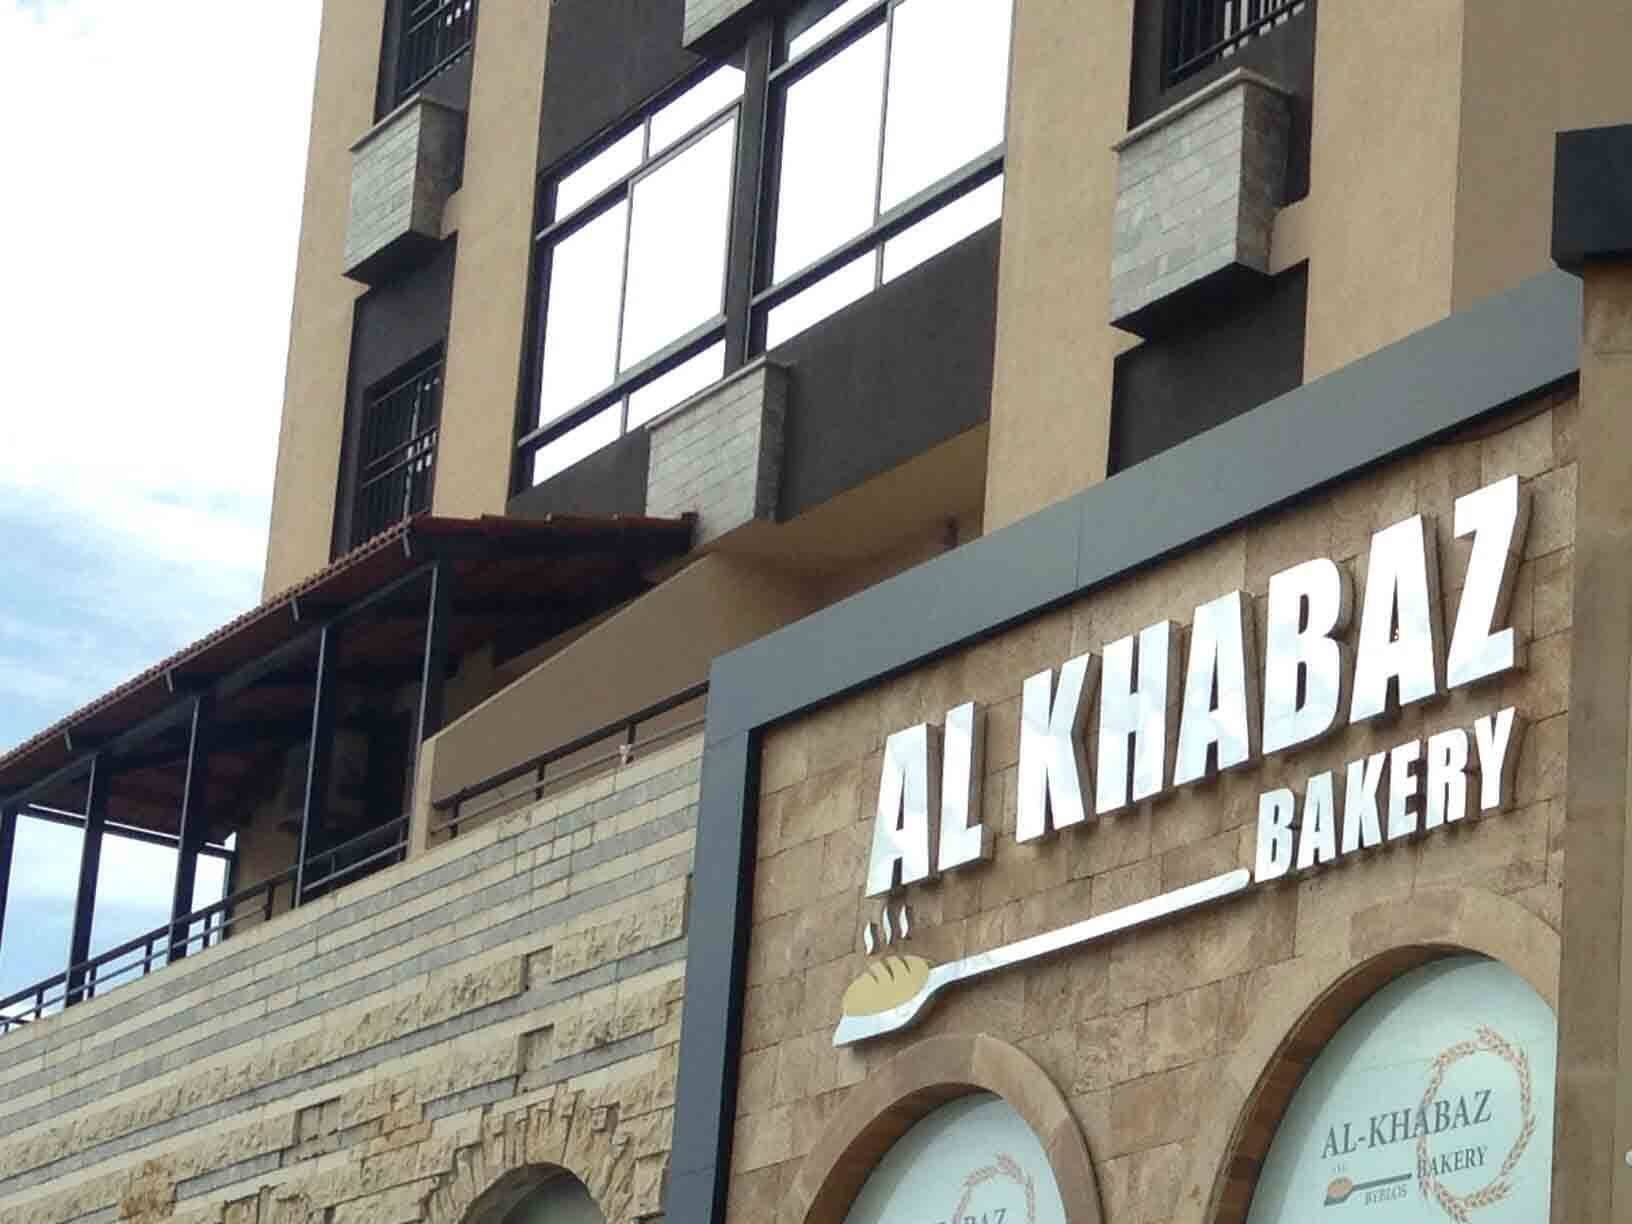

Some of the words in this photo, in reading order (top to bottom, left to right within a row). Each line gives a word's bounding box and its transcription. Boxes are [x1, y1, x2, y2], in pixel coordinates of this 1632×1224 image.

[865, 701, 990, 898] AL
[1015, 475, 1526, 844] KHABAZ
[1254, 706, 1518, 883] BAKERY
[1321, 1089, 1492, 1159] AL-KHABAZ
[1417, 1145, 1487, 1179] BAKERY
